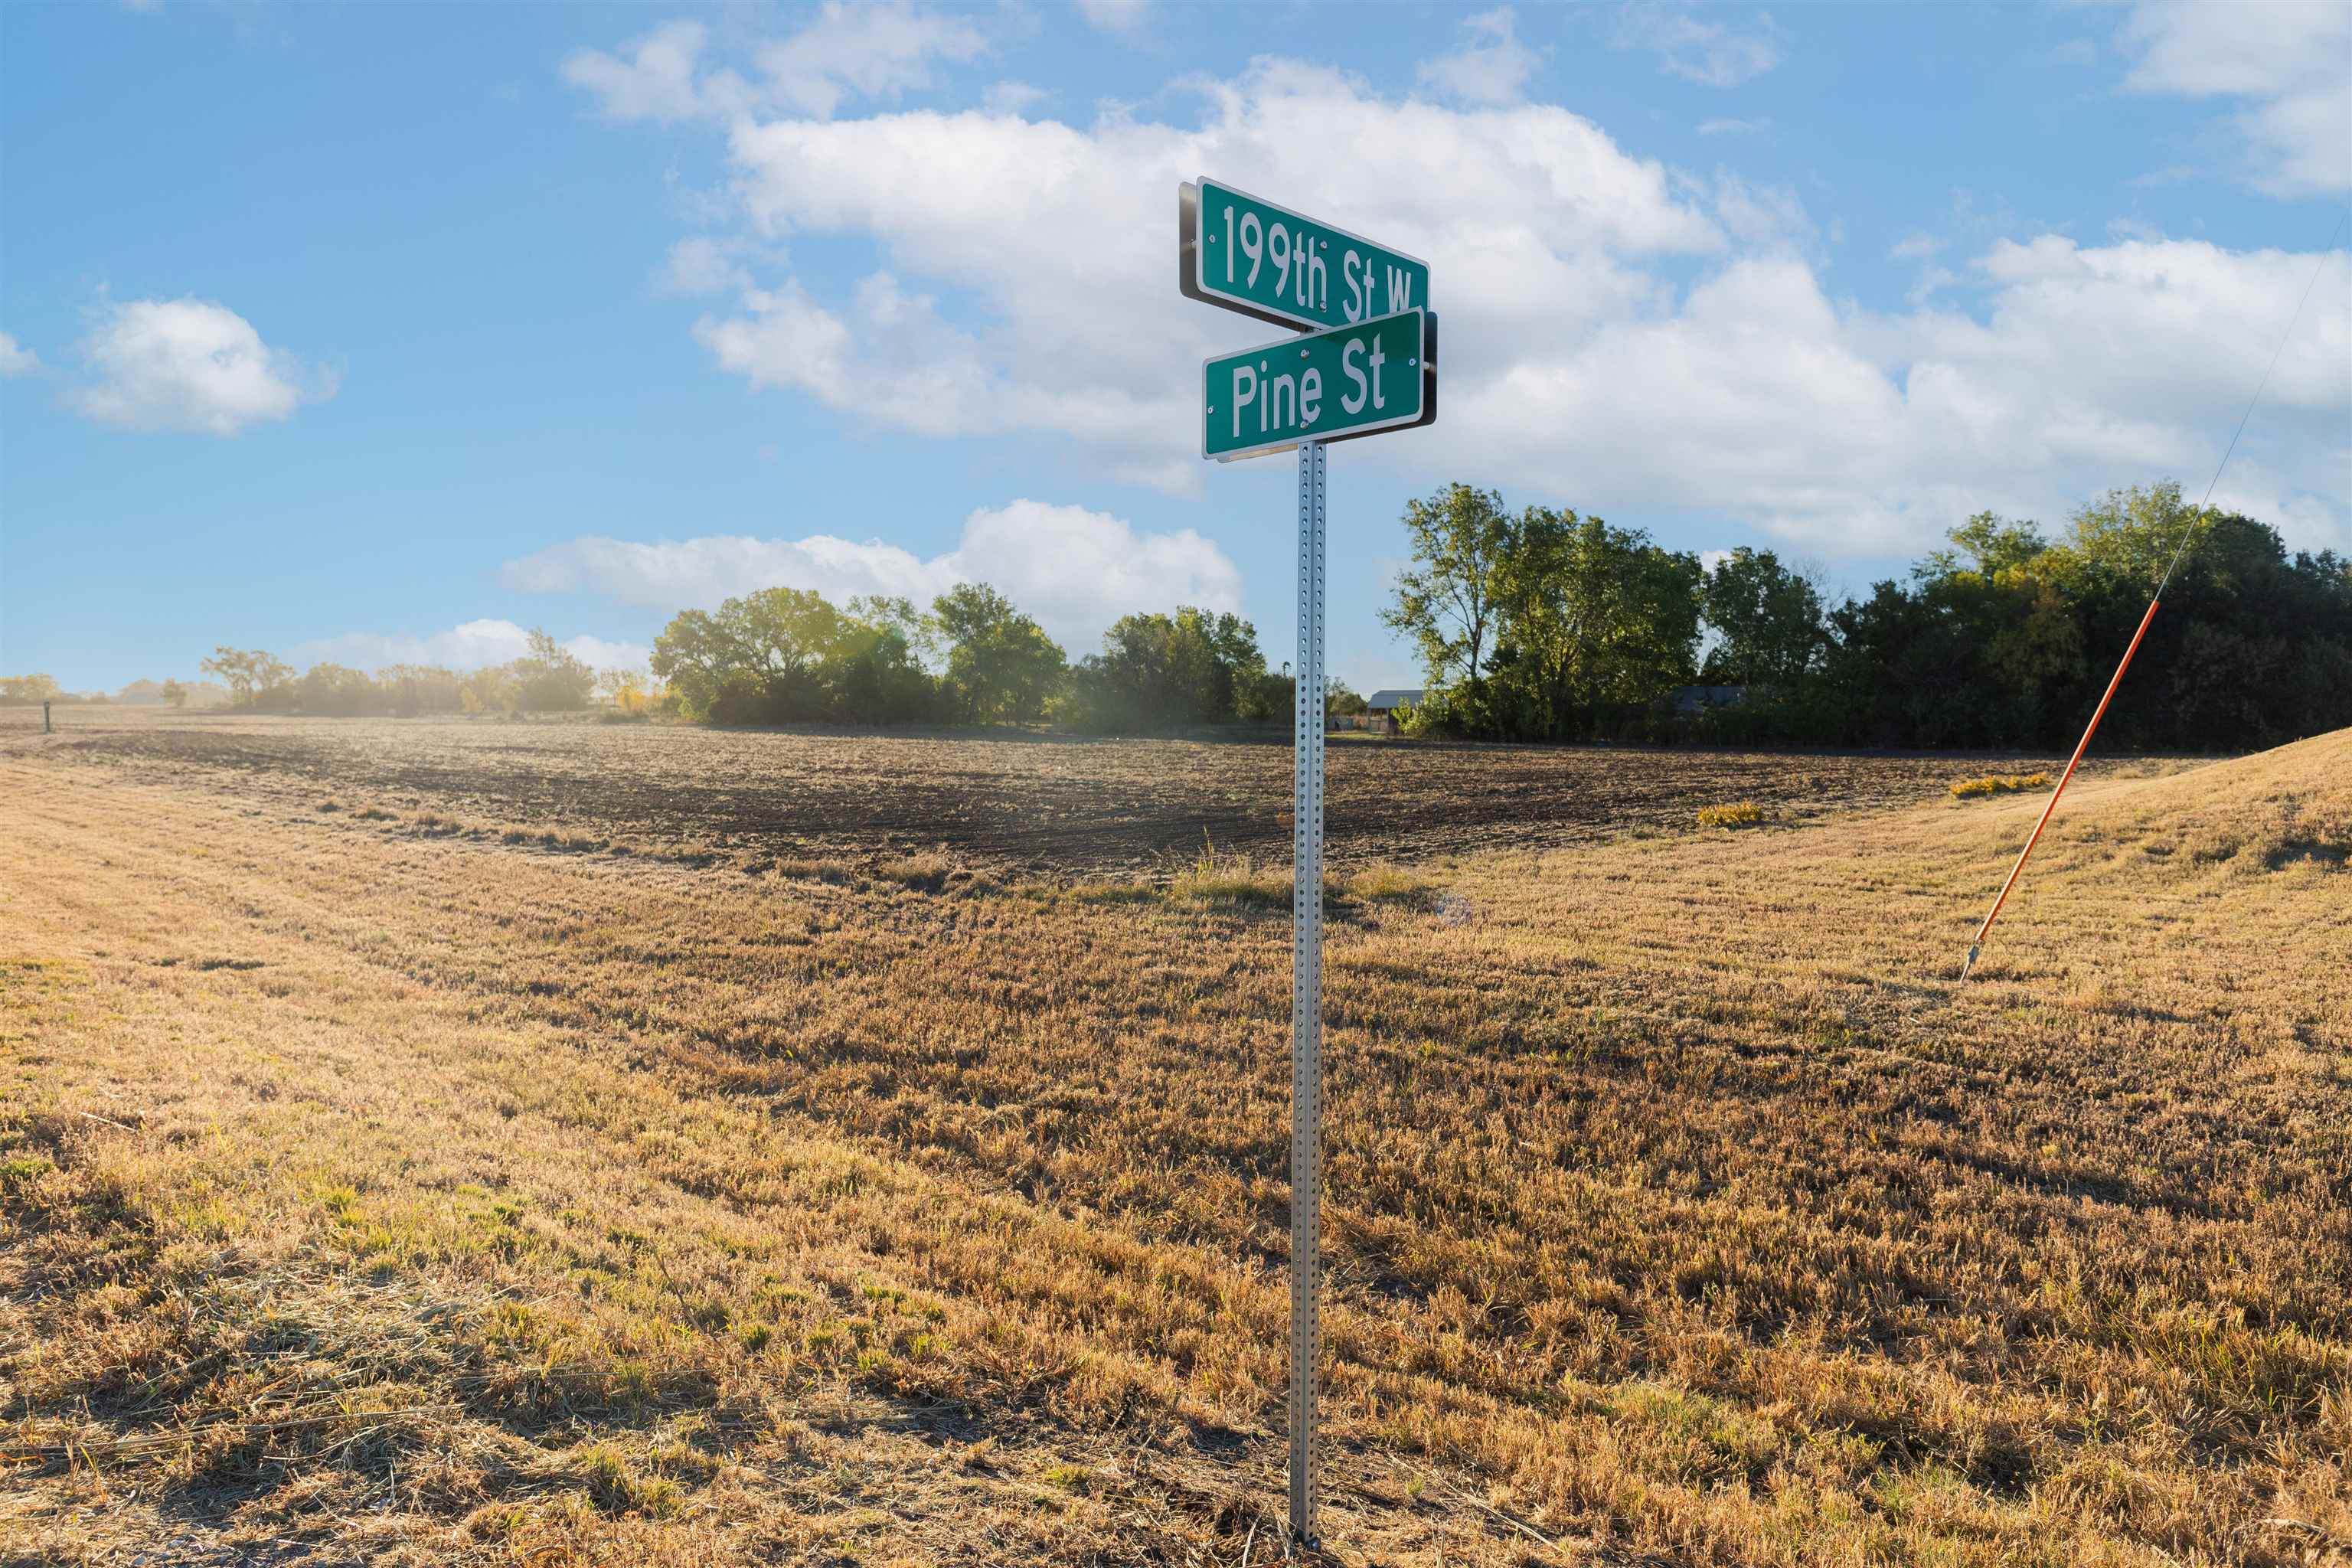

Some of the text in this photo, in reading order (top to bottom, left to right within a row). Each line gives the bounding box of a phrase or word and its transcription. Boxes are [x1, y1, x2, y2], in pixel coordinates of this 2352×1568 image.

[1224, 206, 1412, 322] 199th St W
[1233, 333, 1385, 437] Pine St
